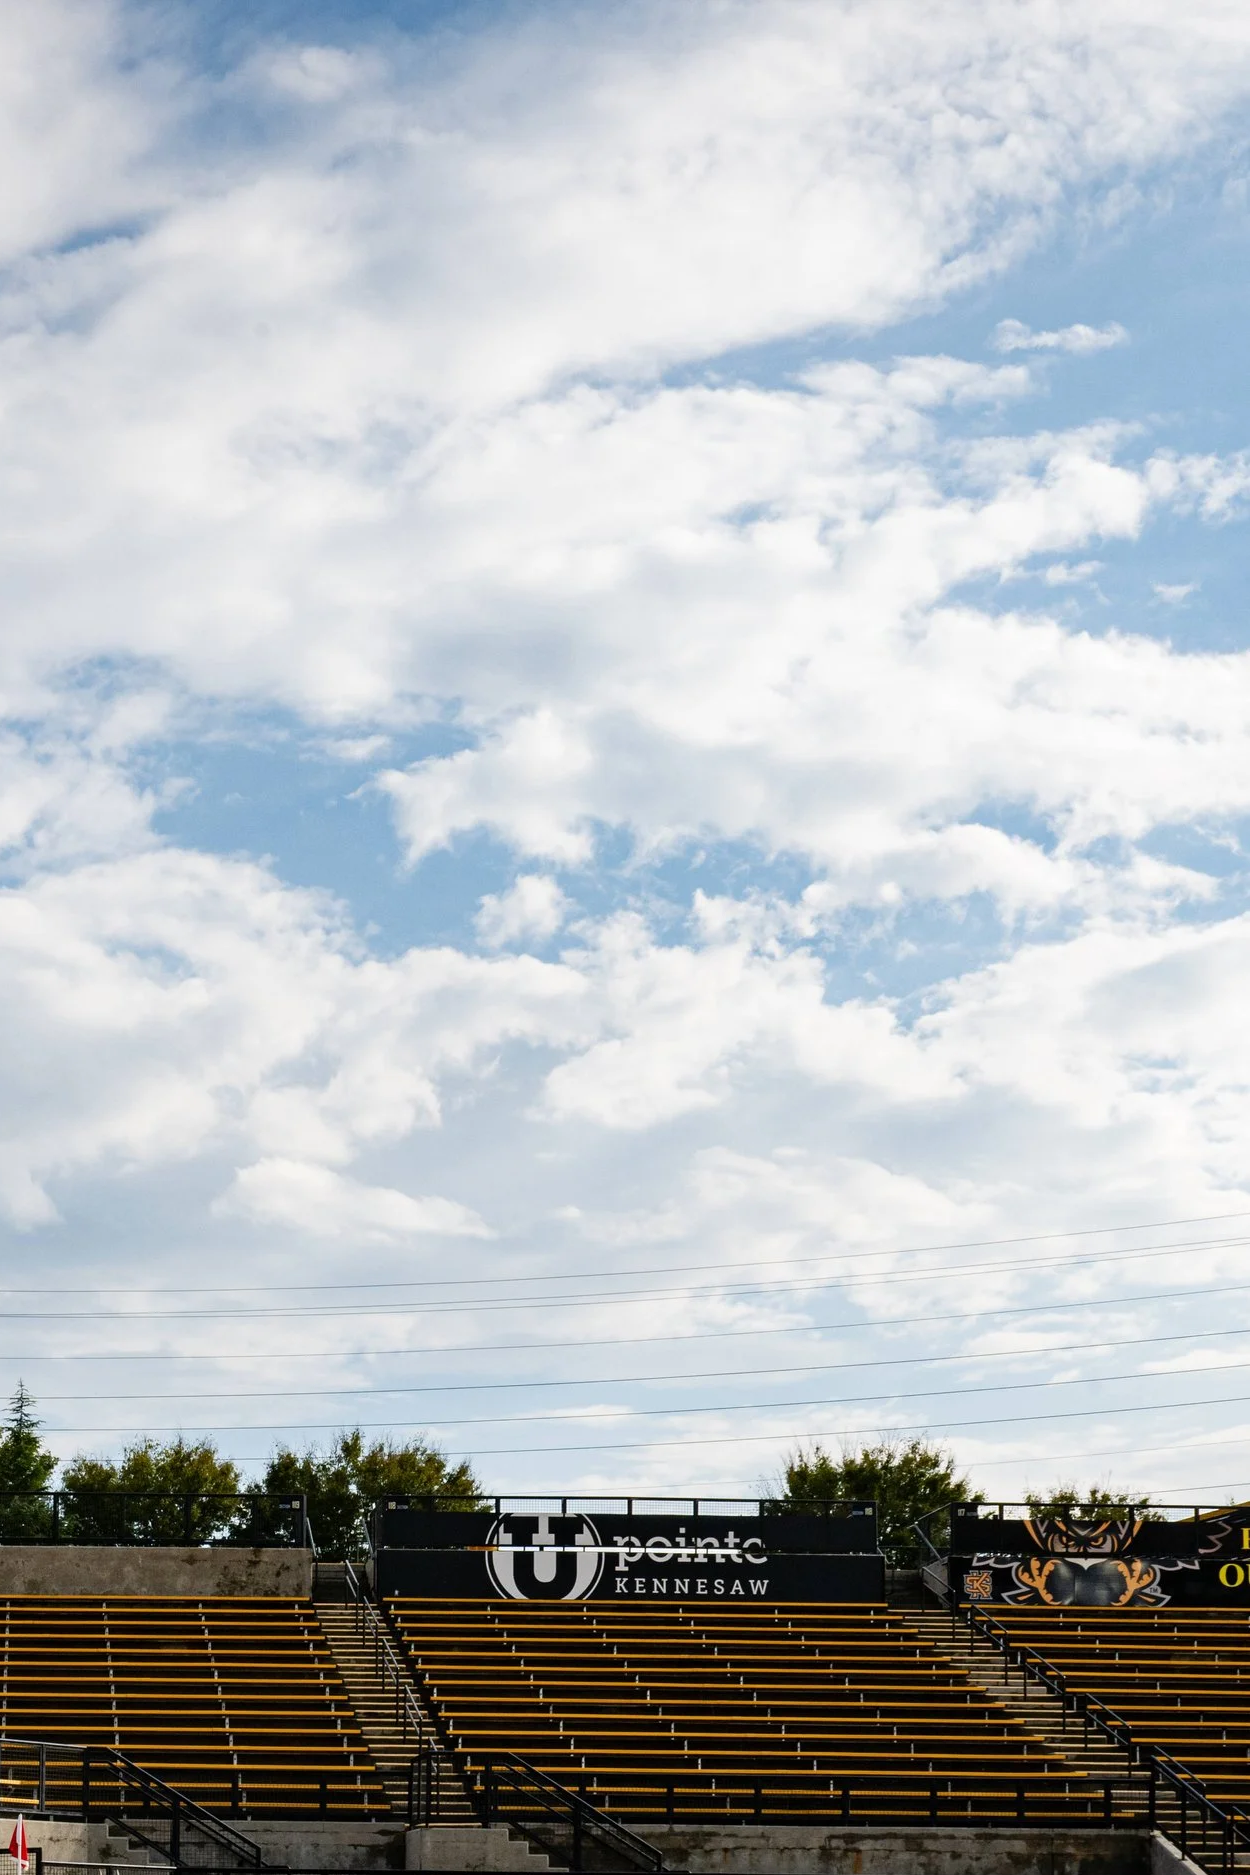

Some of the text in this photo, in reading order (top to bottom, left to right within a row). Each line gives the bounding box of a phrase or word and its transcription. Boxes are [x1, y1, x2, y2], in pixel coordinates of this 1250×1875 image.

[613, 1527, 768, 1572] pointe
[614, 1577, 770, 1595] KENNESAW
[1218, 1563, 1250, 1588] O
